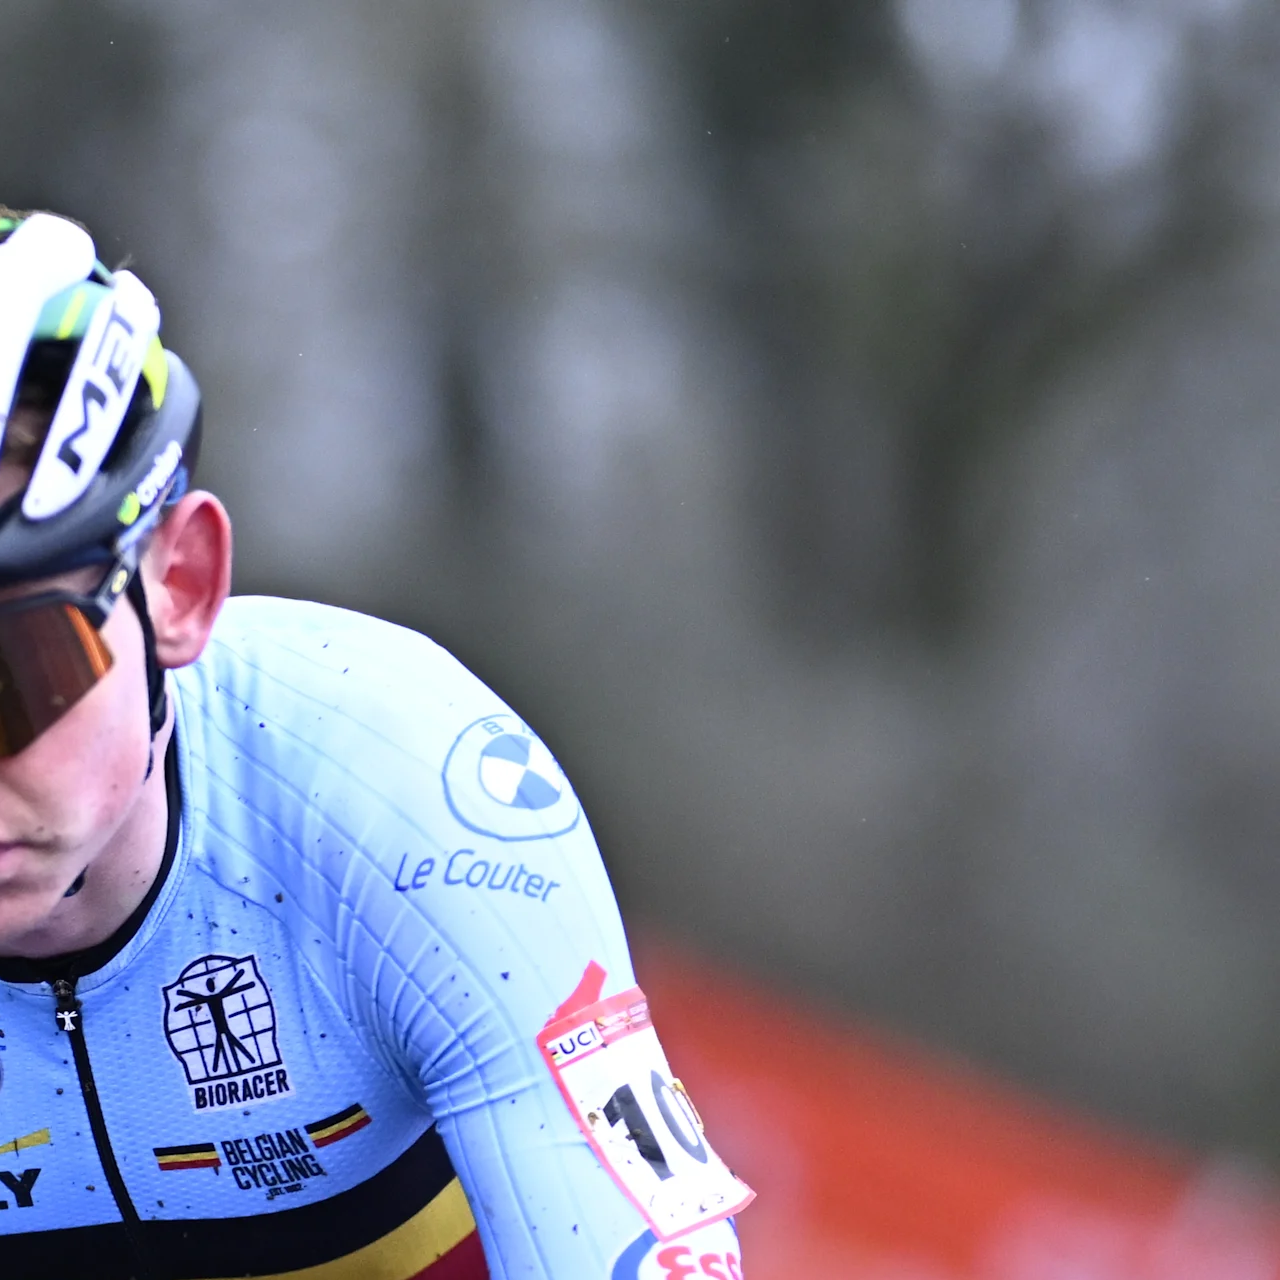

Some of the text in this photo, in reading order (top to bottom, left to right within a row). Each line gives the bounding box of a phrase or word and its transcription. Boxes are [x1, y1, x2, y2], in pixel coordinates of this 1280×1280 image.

[56, 300, 136, 477] MET
[394, 848, 561, 902] Le Couter
[558, 1027, 598, 1055] UCI
[194, 1068, 290, 1109] BIORACER
[602, 1069, 708, 1182] 10
[220, 1128, 310, 1166] BELGIAN
[231, 1154, 324, 1190] CYCLING
